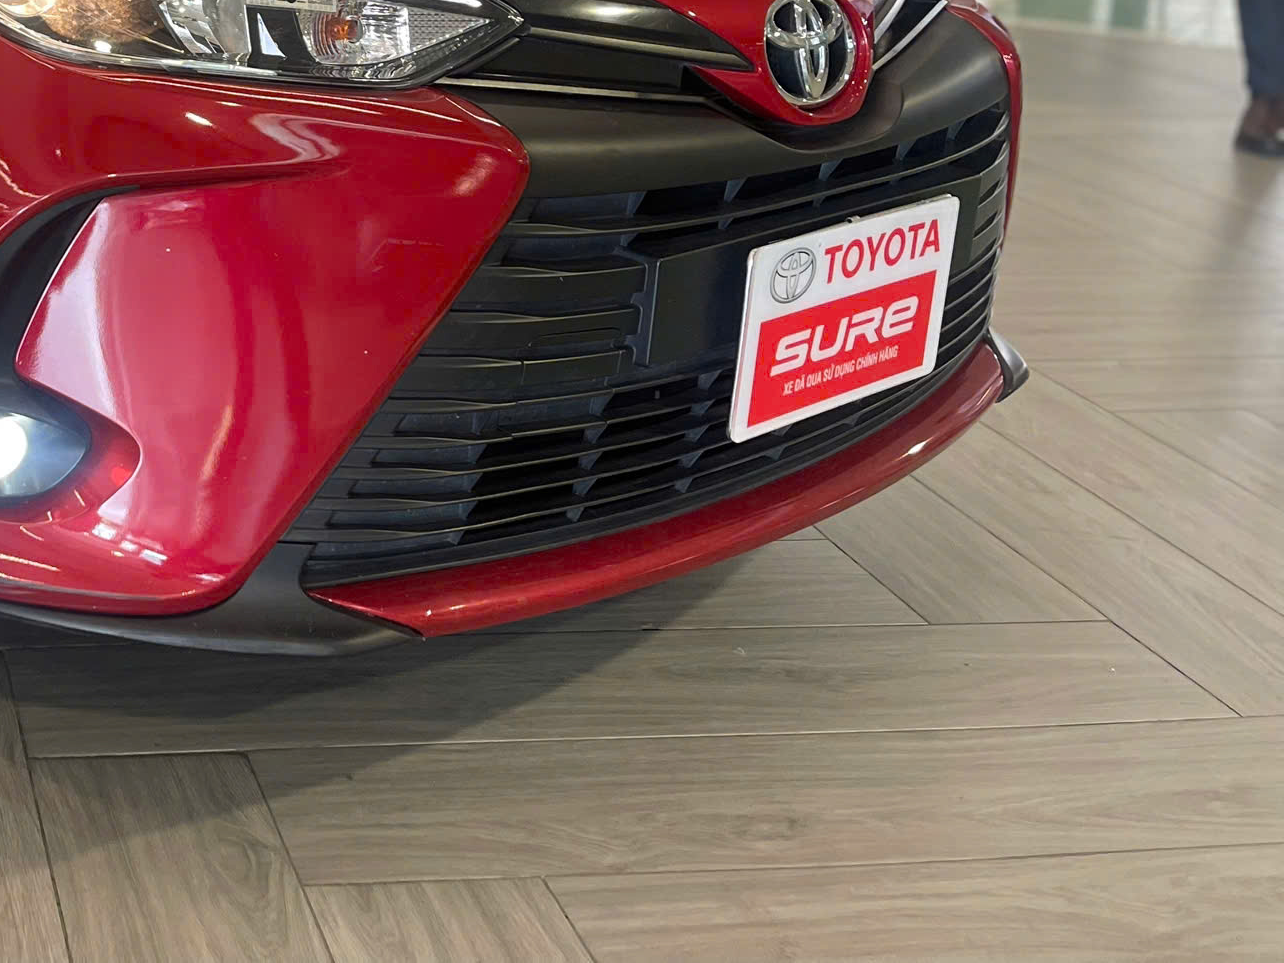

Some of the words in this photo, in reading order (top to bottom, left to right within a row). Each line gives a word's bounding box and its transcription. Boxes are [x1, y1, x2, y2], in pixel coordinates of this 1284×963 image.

[824, 219, 940, 284] TOYOTA
[770, 296, 919, 377] SURE
[782, 380, 794, 396] XE
[806, 371, 822, 388] QUA
